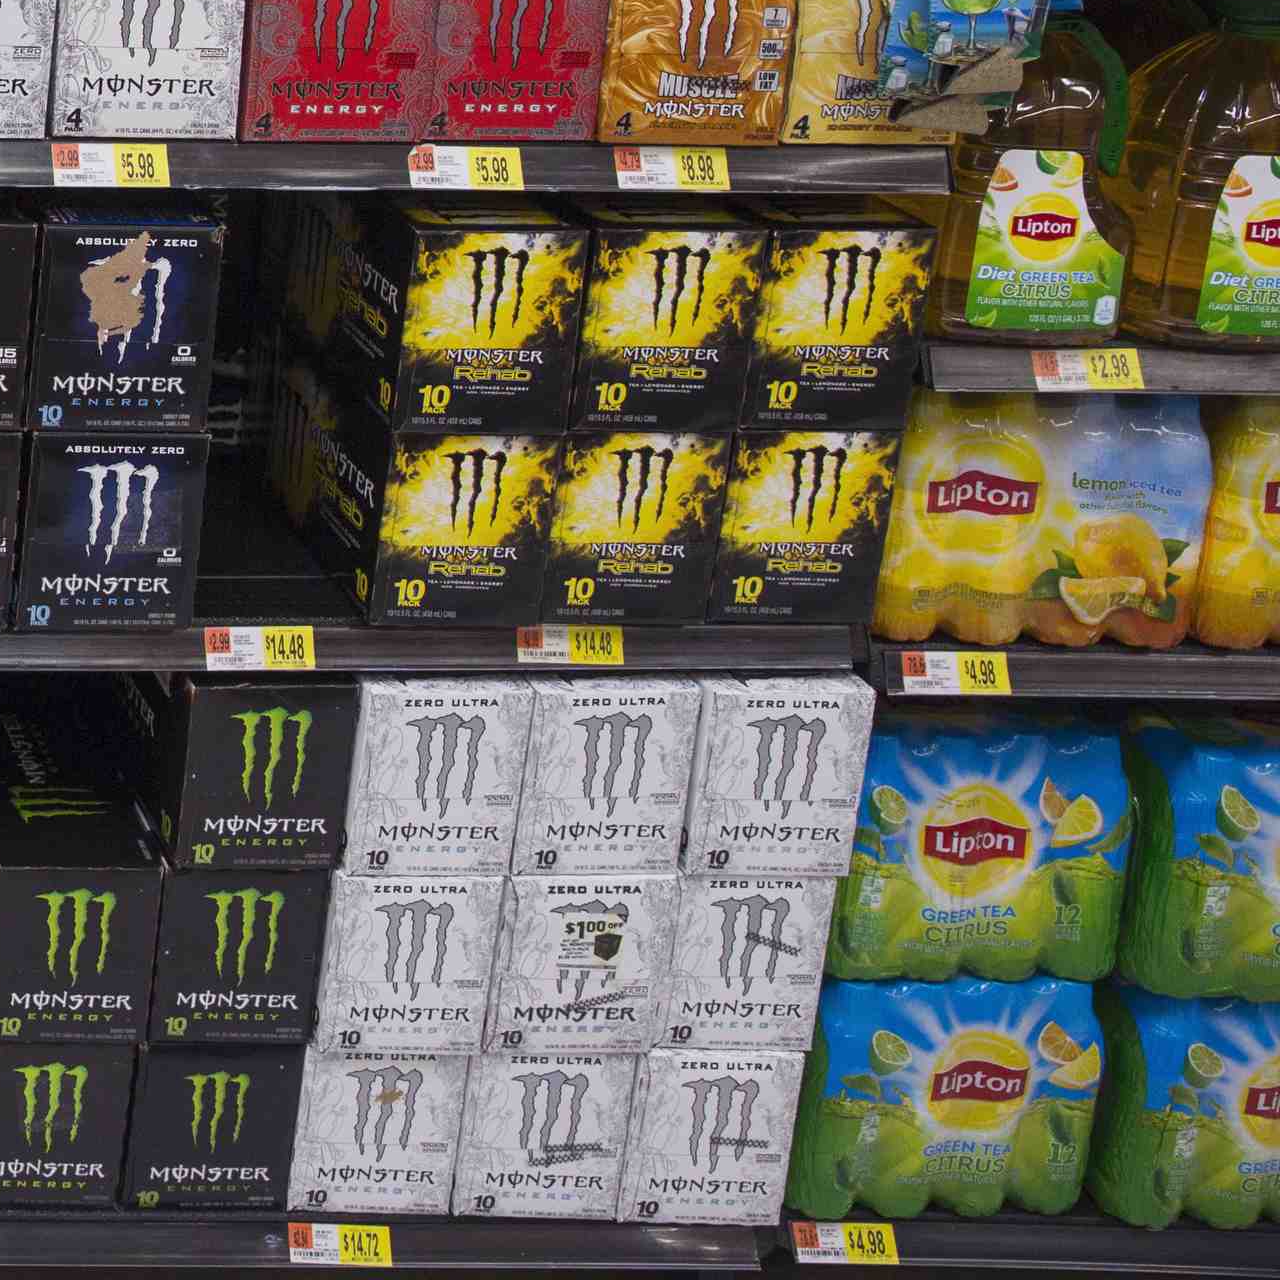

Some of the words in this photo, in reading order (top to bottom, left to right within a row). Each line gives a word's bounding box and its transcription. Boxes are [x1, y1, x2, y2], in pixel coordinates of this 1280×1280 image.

[681, 153, 715, 180] $8.98
[1017, 217, 1072, 237] Lipton
[976, 265, 1017, 283] Diet
[1021, 271, 1067, 282] GREEN
[1072, 272, 1094, 283] TEA
[1001, 282, 1072, 298] CITRUS
[1091, 354, 1129, 378] $2.98
[767, 382, 798, 404] 10
[66, 445, 146, 455] ABSOLUTELY
[151, 445, 185, 455] ZERO
[1072, 472, 1125, 490] lemon
[937, 481, 1029, 508] Lipton
[264, 633, 304, 660] $14.48
[965, 661, 996, 685] $4.98
[405, 698, 444, 708] ZERO
[451, 698, 499, 708] ULTRA
[935, 830, 1016, 855] Lipton
[921, 906, 977, 922] GREEN
[983, 906, 1016, 919] TEA
[925, 921, 1007, 943] CITRUS
[343, 1232, 380, 1256] $14.72
[848, 1230, 886, 1256] $4.98
